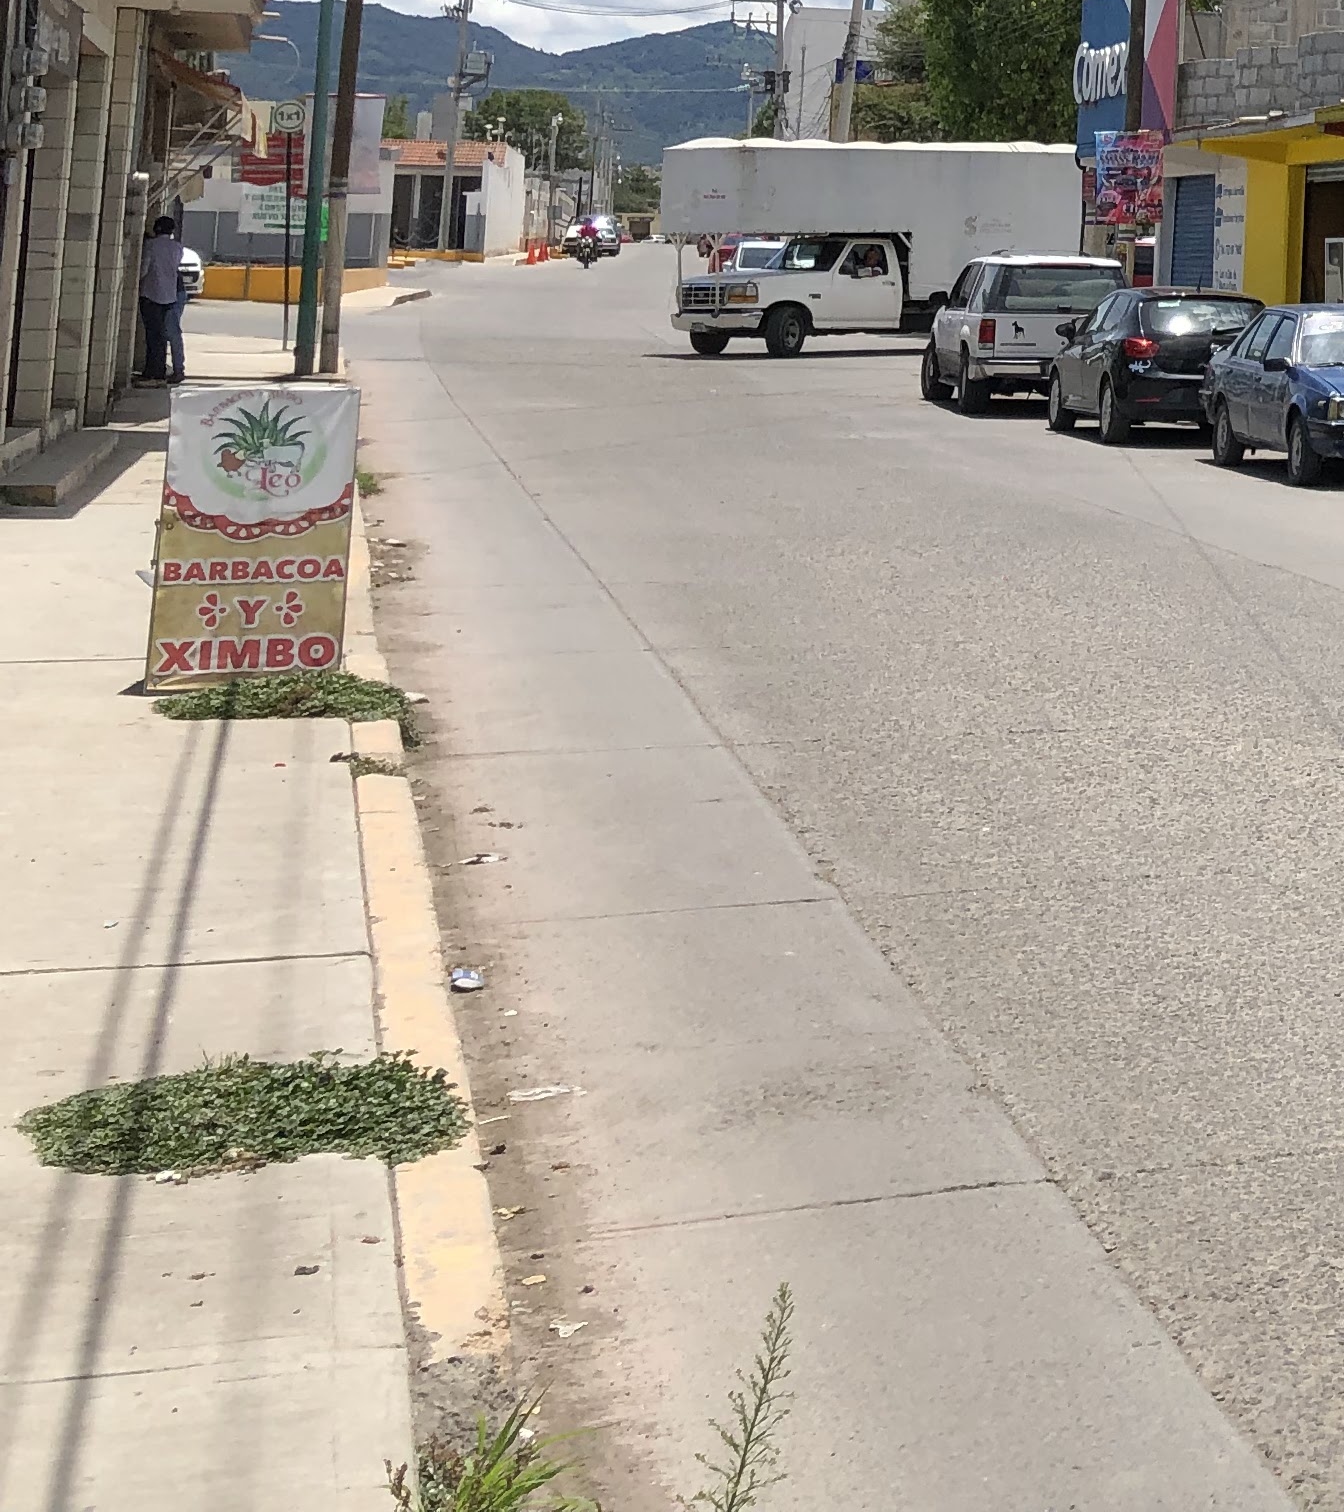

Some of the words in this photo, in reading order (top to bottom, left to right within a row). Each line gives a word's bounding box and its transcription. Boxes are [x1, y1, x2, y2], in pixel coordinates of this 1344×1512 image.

[162, 557, 345, 582] BARBACOA
[235, 599, 268, 626] Y
[156, 635, 337, 673] XIMBO
